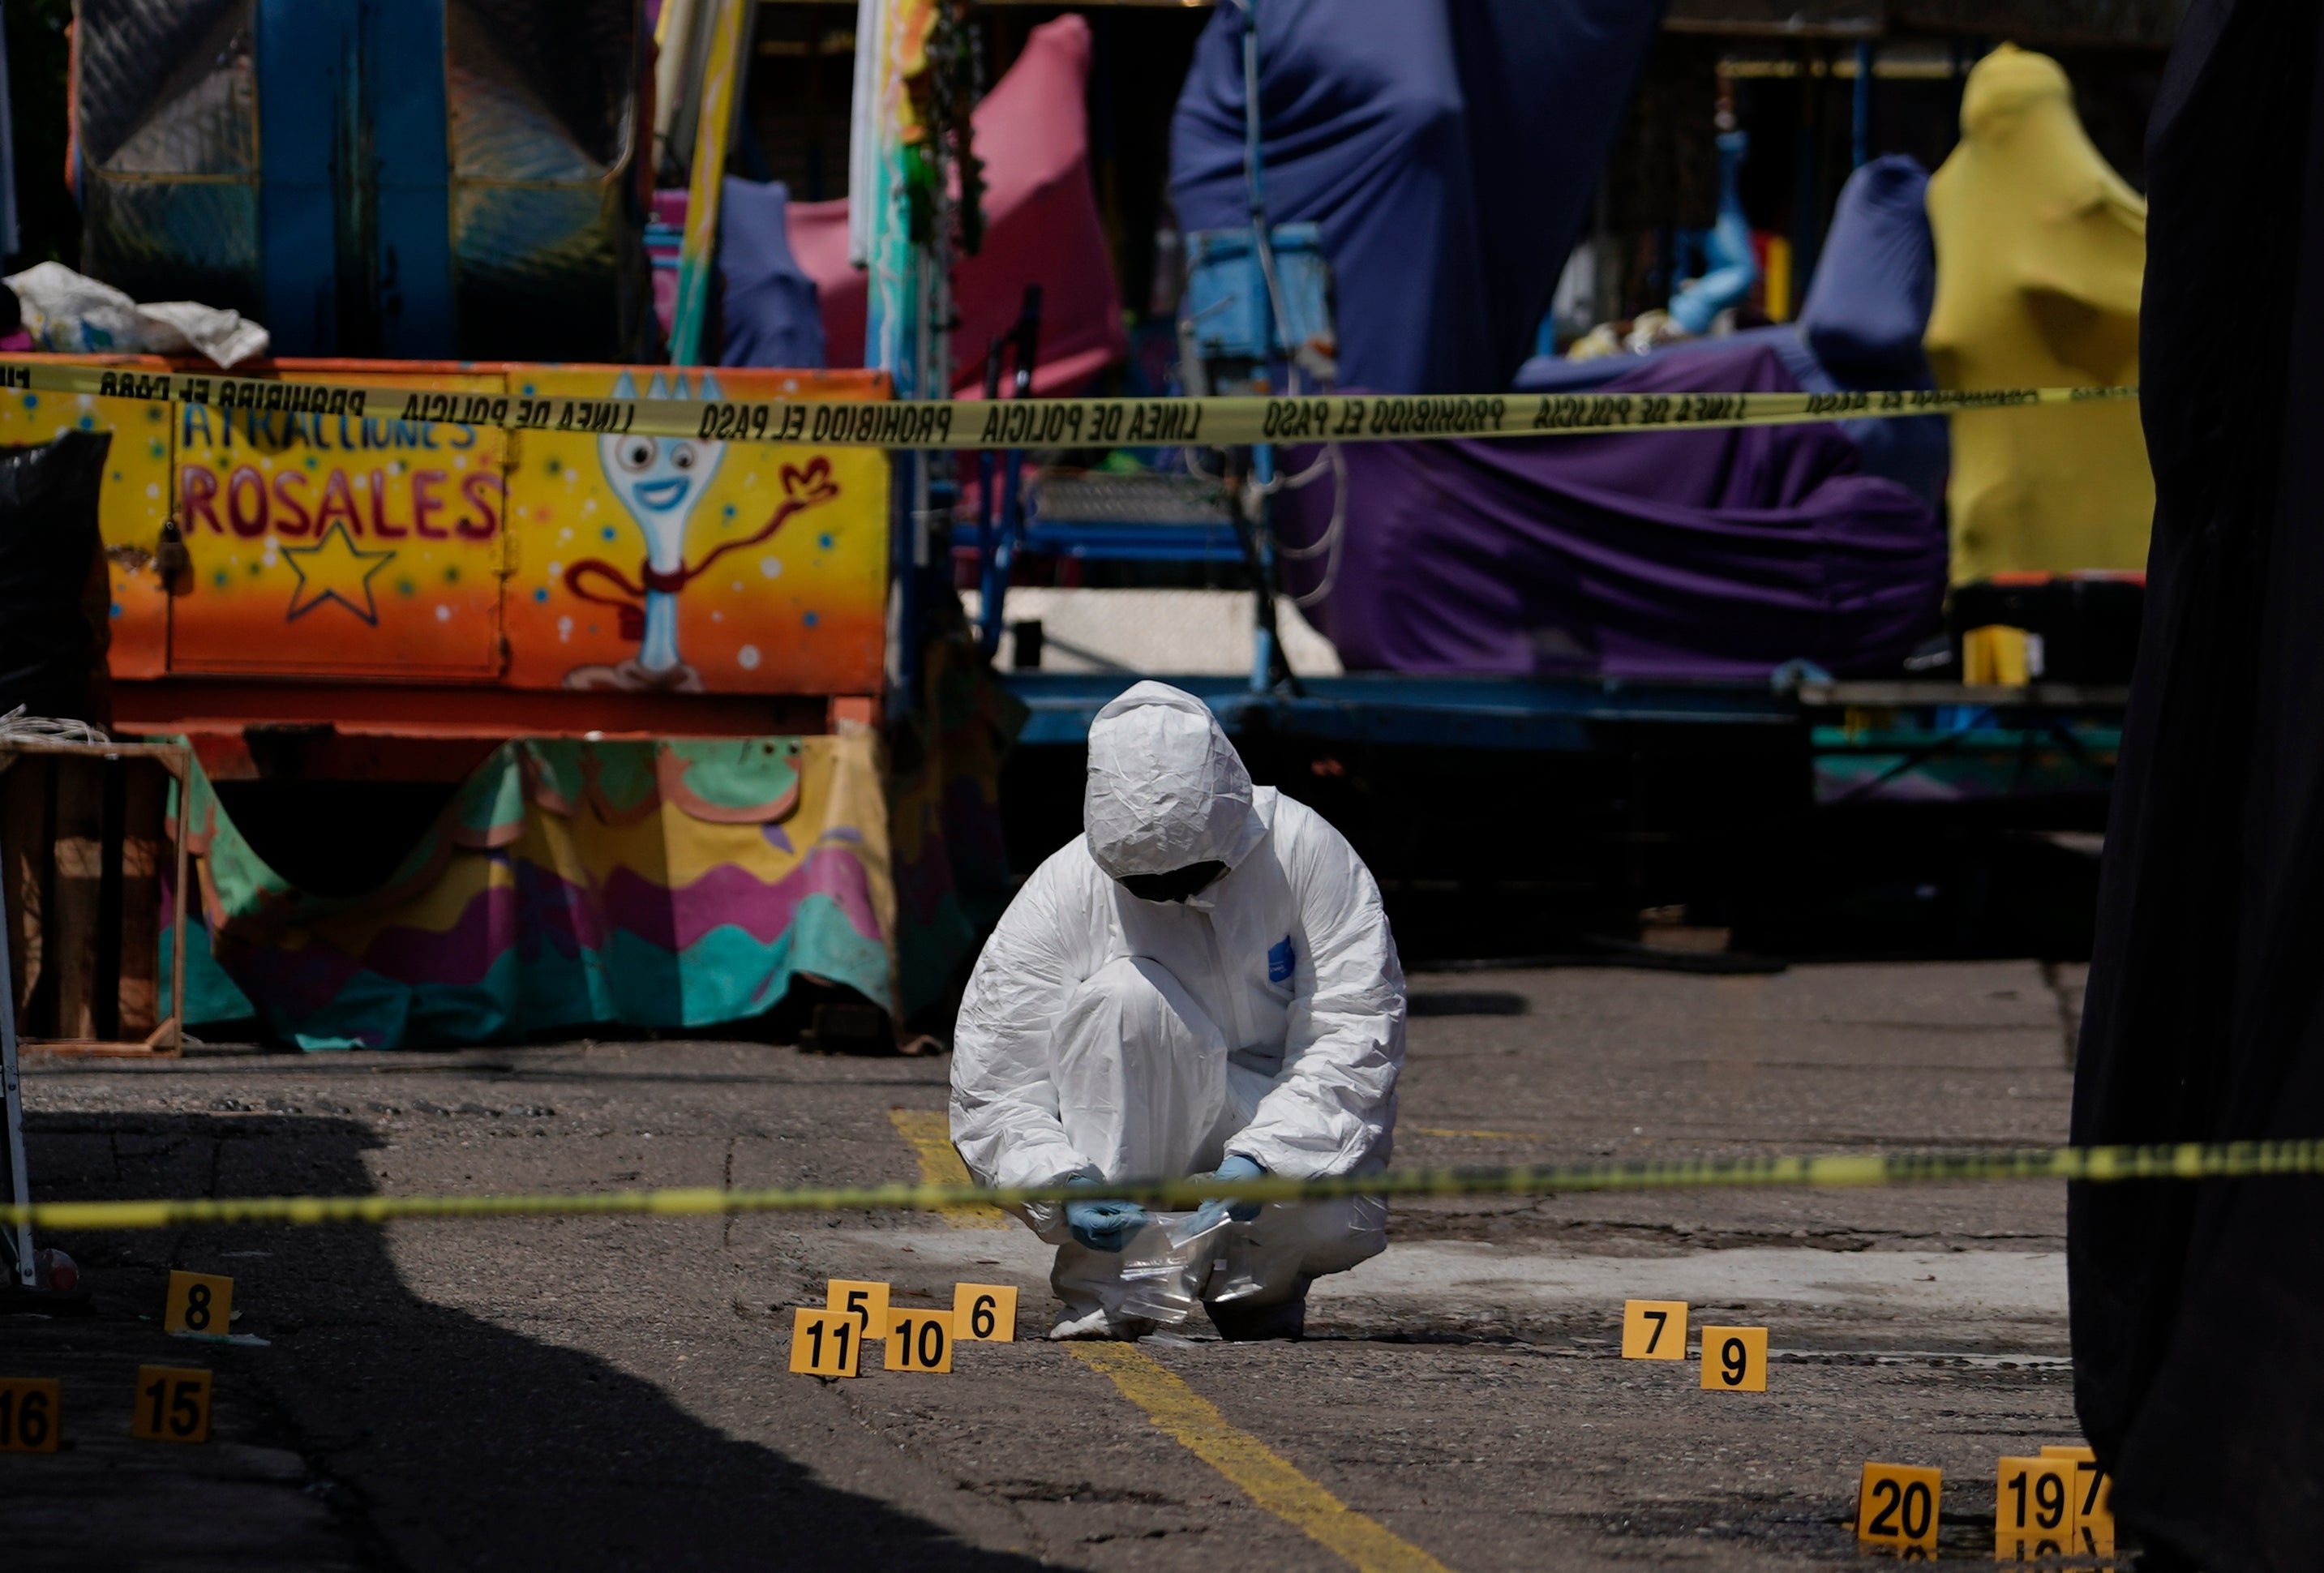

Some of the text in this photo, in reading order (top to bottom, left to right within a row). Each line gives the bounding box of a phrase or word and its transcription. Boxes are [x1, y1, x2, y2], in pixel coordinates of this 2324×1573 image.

[180, 463, 510, 542] ROSALES
[185, 1284, 211, 1331] 8
[847, 1291, 868, 1333] 5
[971, 1295, 996, 1338] 6
[807, 1320, 850, 1369] 11
[895, 1319, 944, 1367] 10
[1644, 1311, 1667, 1353] 7
[1722, 1338, 1747, 1386] 9
[0, 1389, 49, 1447] 16
[146, 1379, 202, 1437] 15
[1868, 1478, 1932, 1539] 20
[2008, 1472, 2065, 1529] 19
